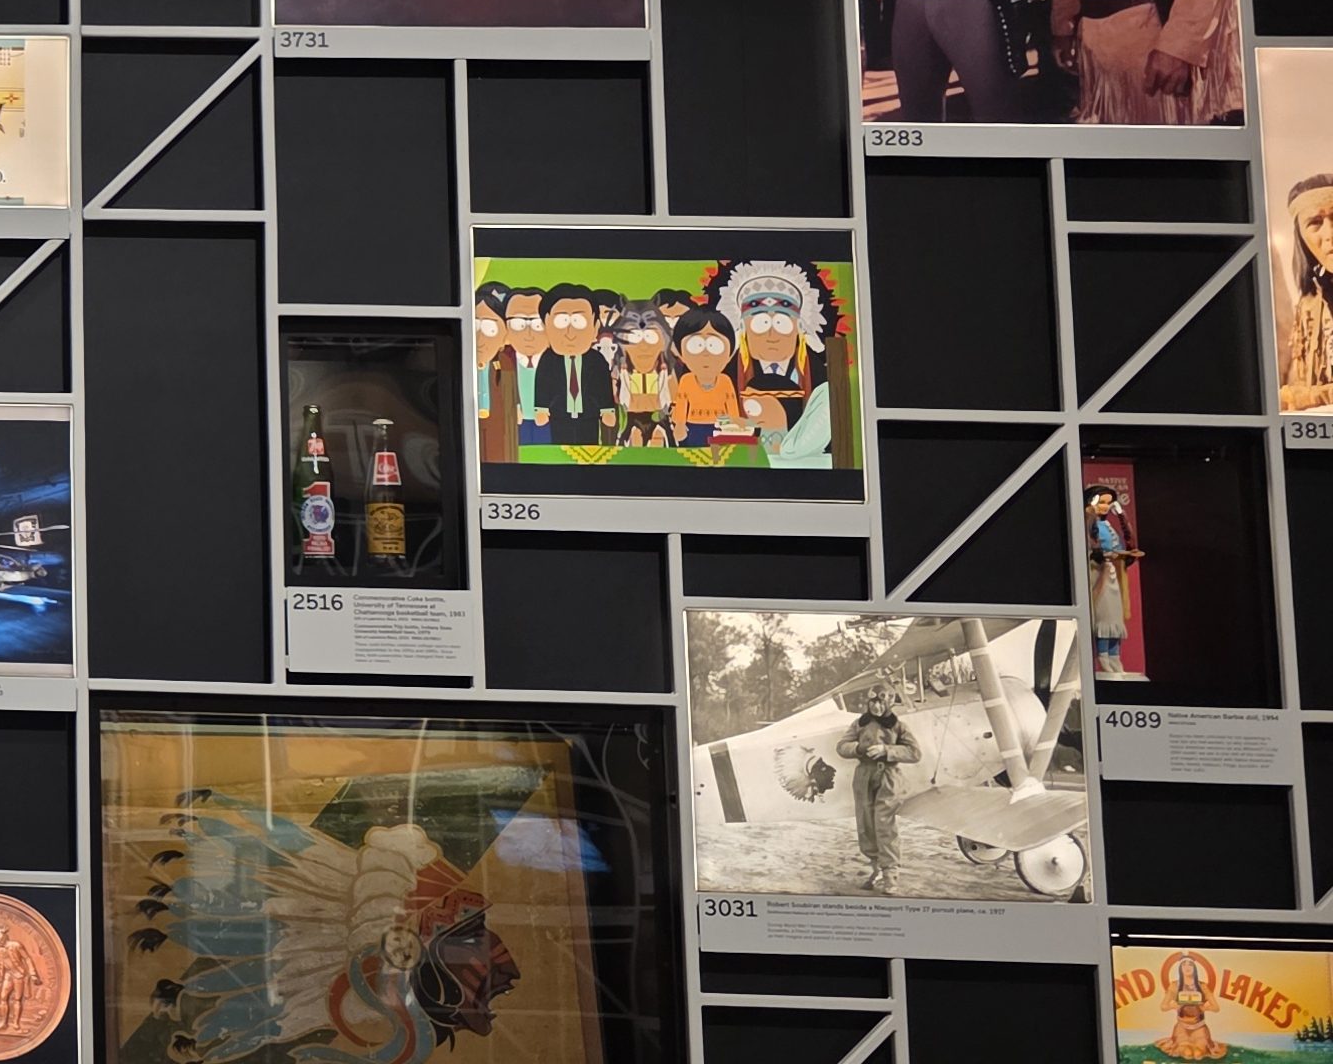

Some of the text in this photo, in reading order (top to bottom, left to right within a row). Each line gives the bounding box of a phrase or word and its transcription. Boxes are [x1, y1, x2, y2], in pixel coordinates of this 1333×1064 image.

[279, 31, 329, 49] 3731
[871, 130, 924, 147] 3283
[488, 502, 541, 521] 3326
[293, 593, 343, 611] 2516
[1105, 710, 1162, 729] 4089
[704, 899, 758, 918] 3031
[1219, 968, 1302, 1030] LAKES
